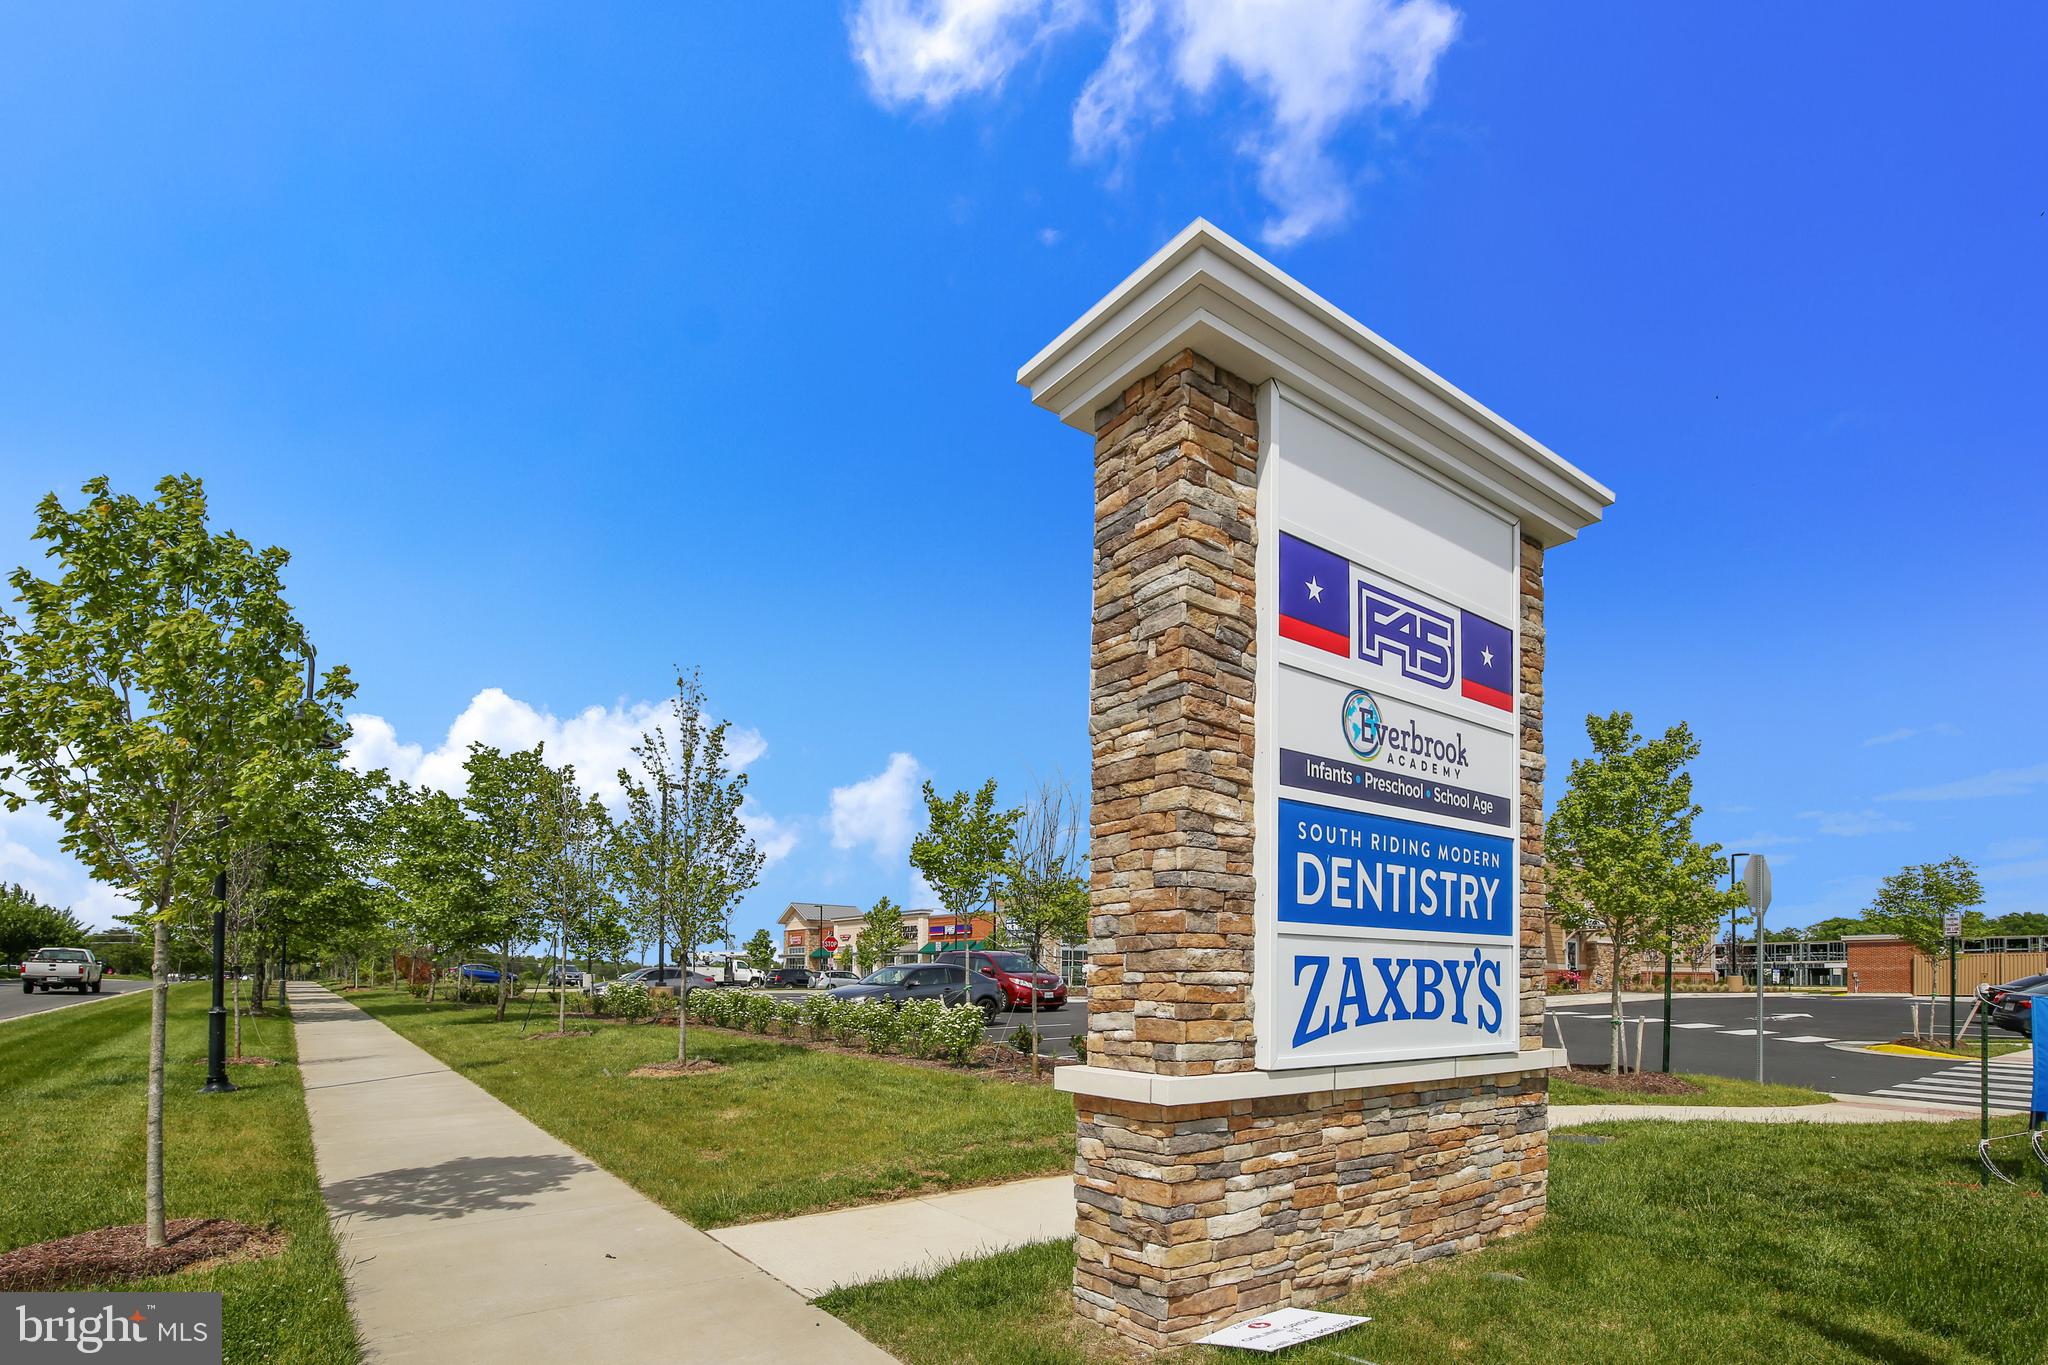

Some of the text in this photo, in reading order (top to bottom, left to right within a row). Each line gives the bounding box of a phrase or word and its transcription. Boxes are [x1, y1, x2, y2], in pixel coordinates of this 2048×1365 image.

[1361, 588, 1453, 687] F45
[1359, 707, 1469, 767] Everbrook
[1387, 753, 1461, 779] ACADEMY
[1306, 759, 1494, 815] Infants Preschool School Age
[1298, 821, 1500, 869] SOUTH RIDING MODERN
[1296, 852, 1500, 921] DENTISTRY
[824, 940, 838, 948] STOP
[1292, 947, 1503, 1049] ZAXBY'S
